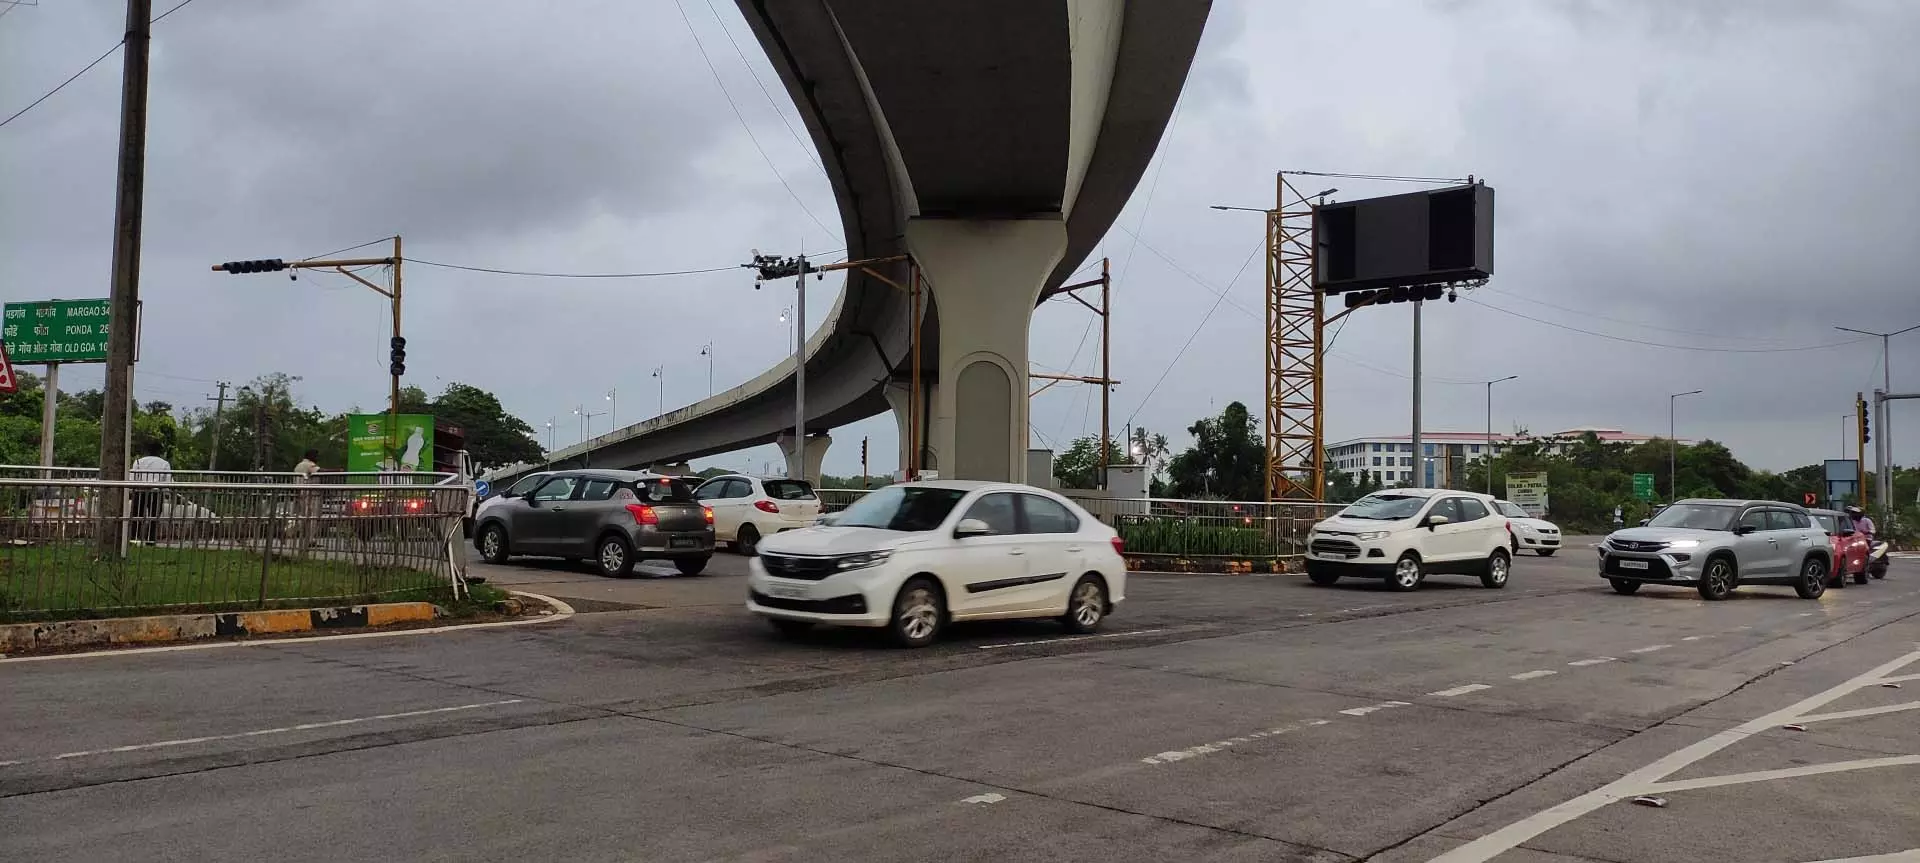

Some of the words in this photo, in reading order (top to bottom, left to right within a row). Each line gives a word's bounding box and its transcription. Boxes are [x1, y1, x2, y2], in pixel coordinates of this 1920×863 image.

[66, 306, 100, 317] MARGAO
[100, 306, 111, 316] 34
[66, 325, 92, 335] PONDA
[64, 343, 79, 353] OLD
[80, 342, 96, 352] GOA
[98, 341, 109, 352] 10
